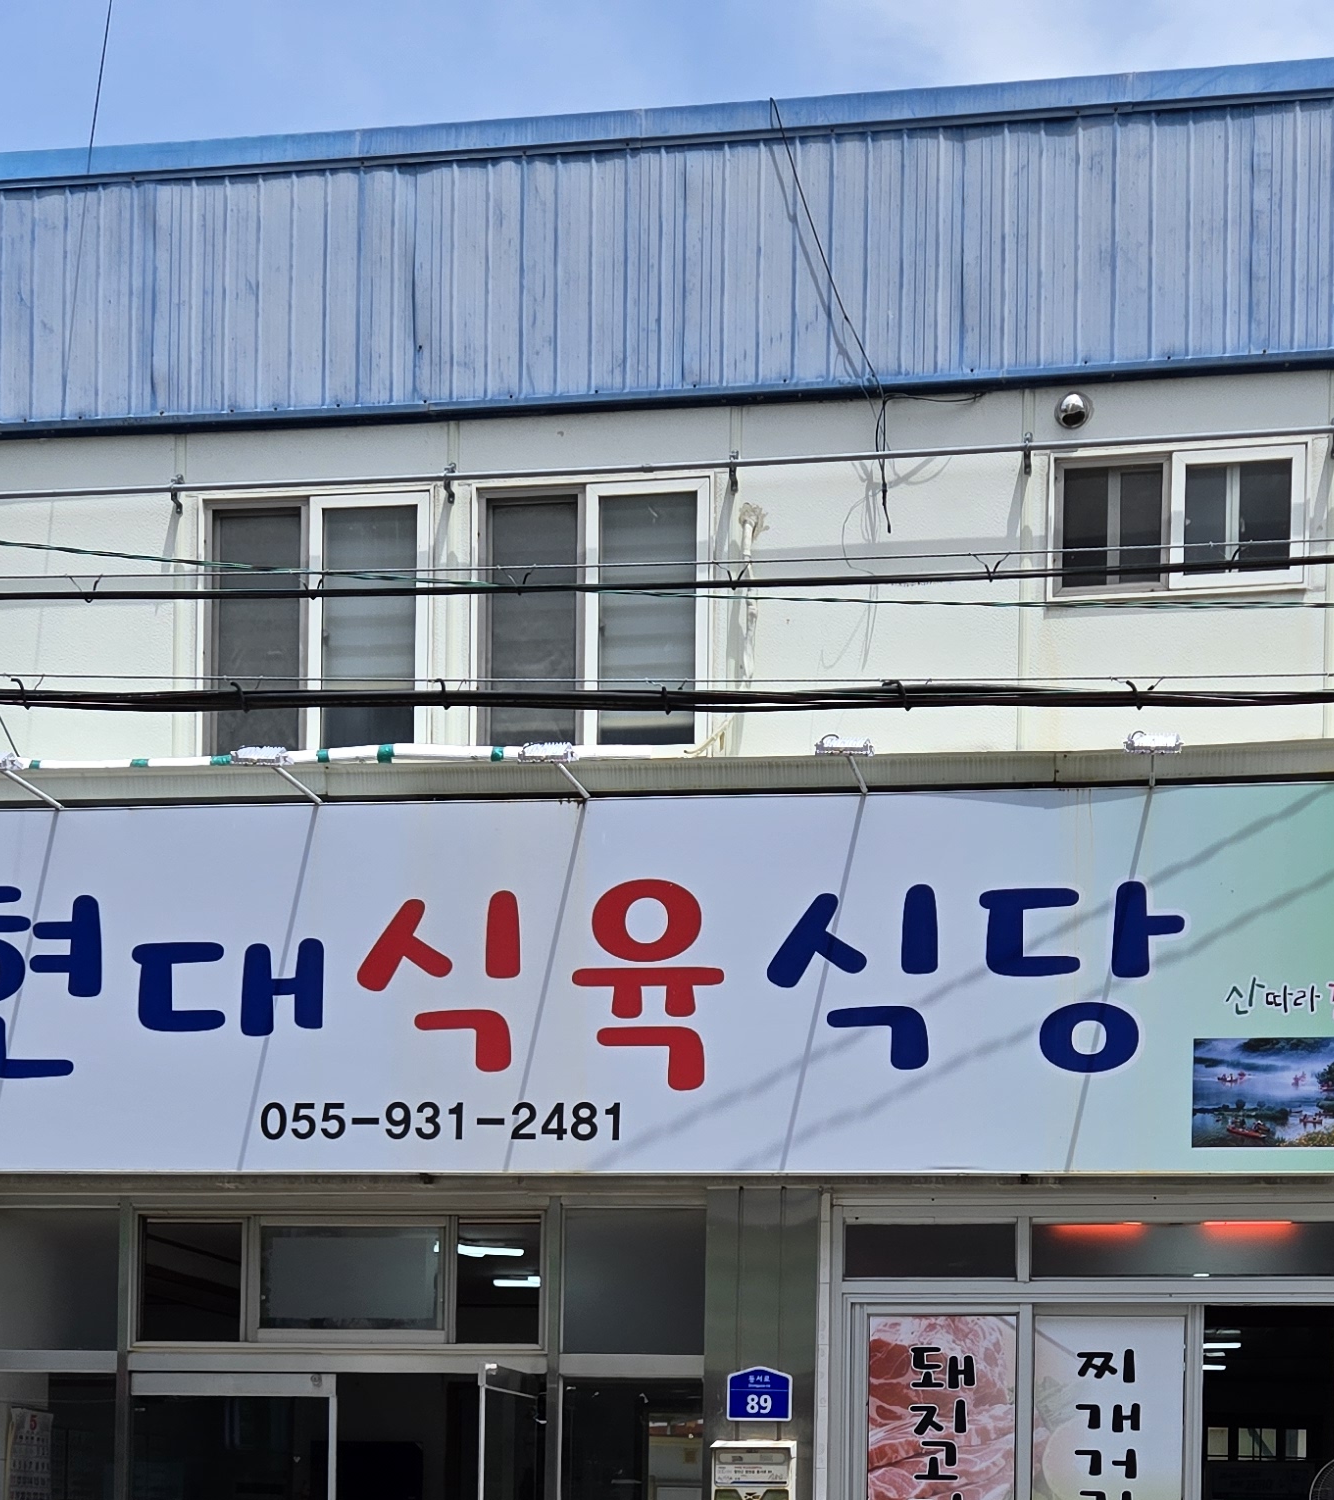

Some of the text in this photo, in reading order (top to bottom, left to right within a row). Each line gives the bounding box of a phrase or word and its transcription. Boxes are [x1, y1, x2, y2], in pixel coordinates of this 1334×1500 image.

[1226, 977, 1320, 1015] 산따라
[261, 1101, 622, 1141] 055-931-2481
[746, 1394, 772, 1414] 89
[30, 1414, 38, 1431] 5
